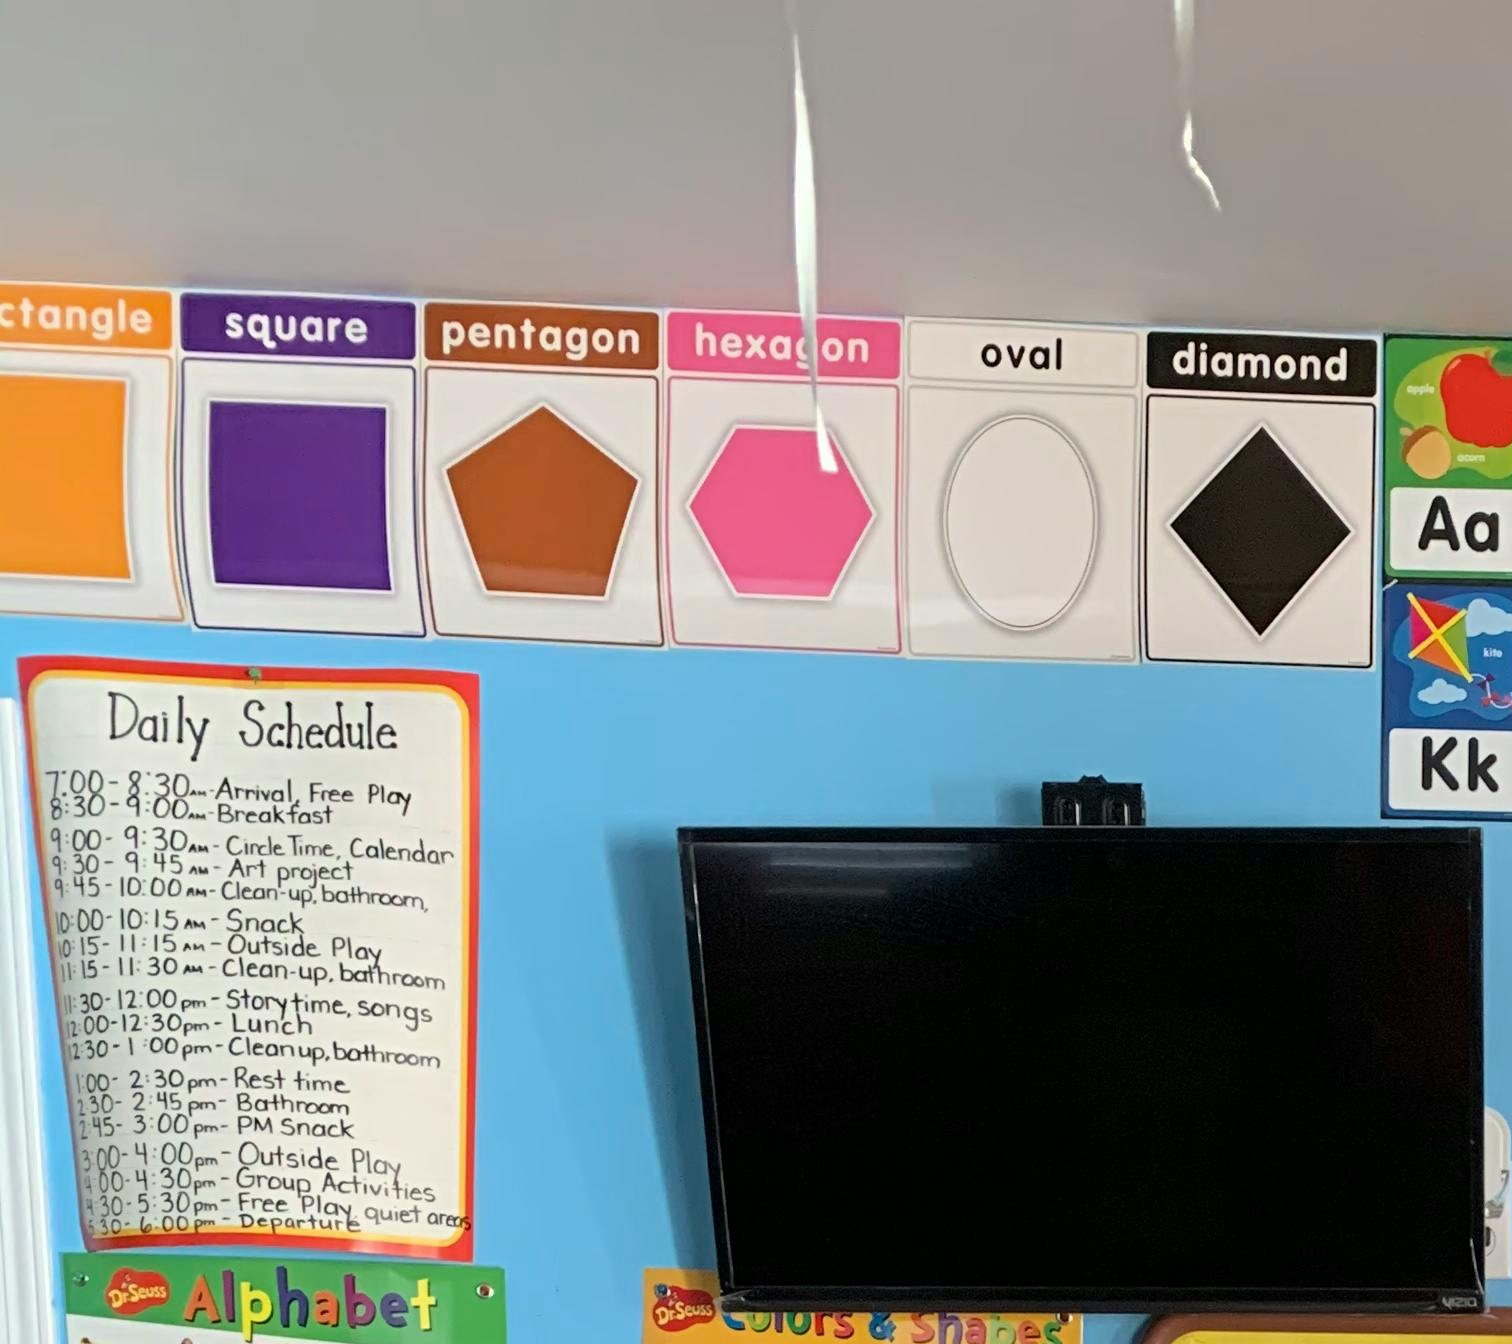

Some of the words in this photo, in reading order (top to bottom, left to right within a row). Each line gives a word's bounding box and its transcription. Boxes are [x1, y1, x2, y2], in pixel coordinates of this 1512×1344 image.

[225, 309, 368, 349] square
[442, 318, 640, 361] pentagon
[981, 338, 1063, 371] oval
[1172, 342, 1348, 384] diamond
[1406, 384, 1435, 396] apple
[1457, 454, 1485, 463] acorn
[1418, 496, 1499, 552] Aa
[108, 691, 210, 761] Daily
[239, 700, 398, 750] Schedule
[1422, 736, 1499, 792] Kk
[218, 805, 333, 825] Breakfast
[310, 783, 353, 802] Free
[368, 784, 411, 816] Play
[229, 860, 265, 878] Art
[278, 861, 353, 887] project
[226, 909, 304, 934] Snack
[228, 939, 320, 957] Outside
[332, 937, 381, 967] Play
[232, 1014, 312, 1035] Lunch
[359, 1000, 431, 1031] songs
[235, 1068, 286, 1090] Rest
[295, 1075, 350, 1094] time
[237, 1093, 349, 1115] Bathroom
[239, 1142, 338, 1170] Outside
[352, 1146, 400, 1184] Play
[237, 1168, 311, 1195] Group
[322, 1177, 435, 1202] Activities
[184, 1266, 437, 1343] Alphabet
